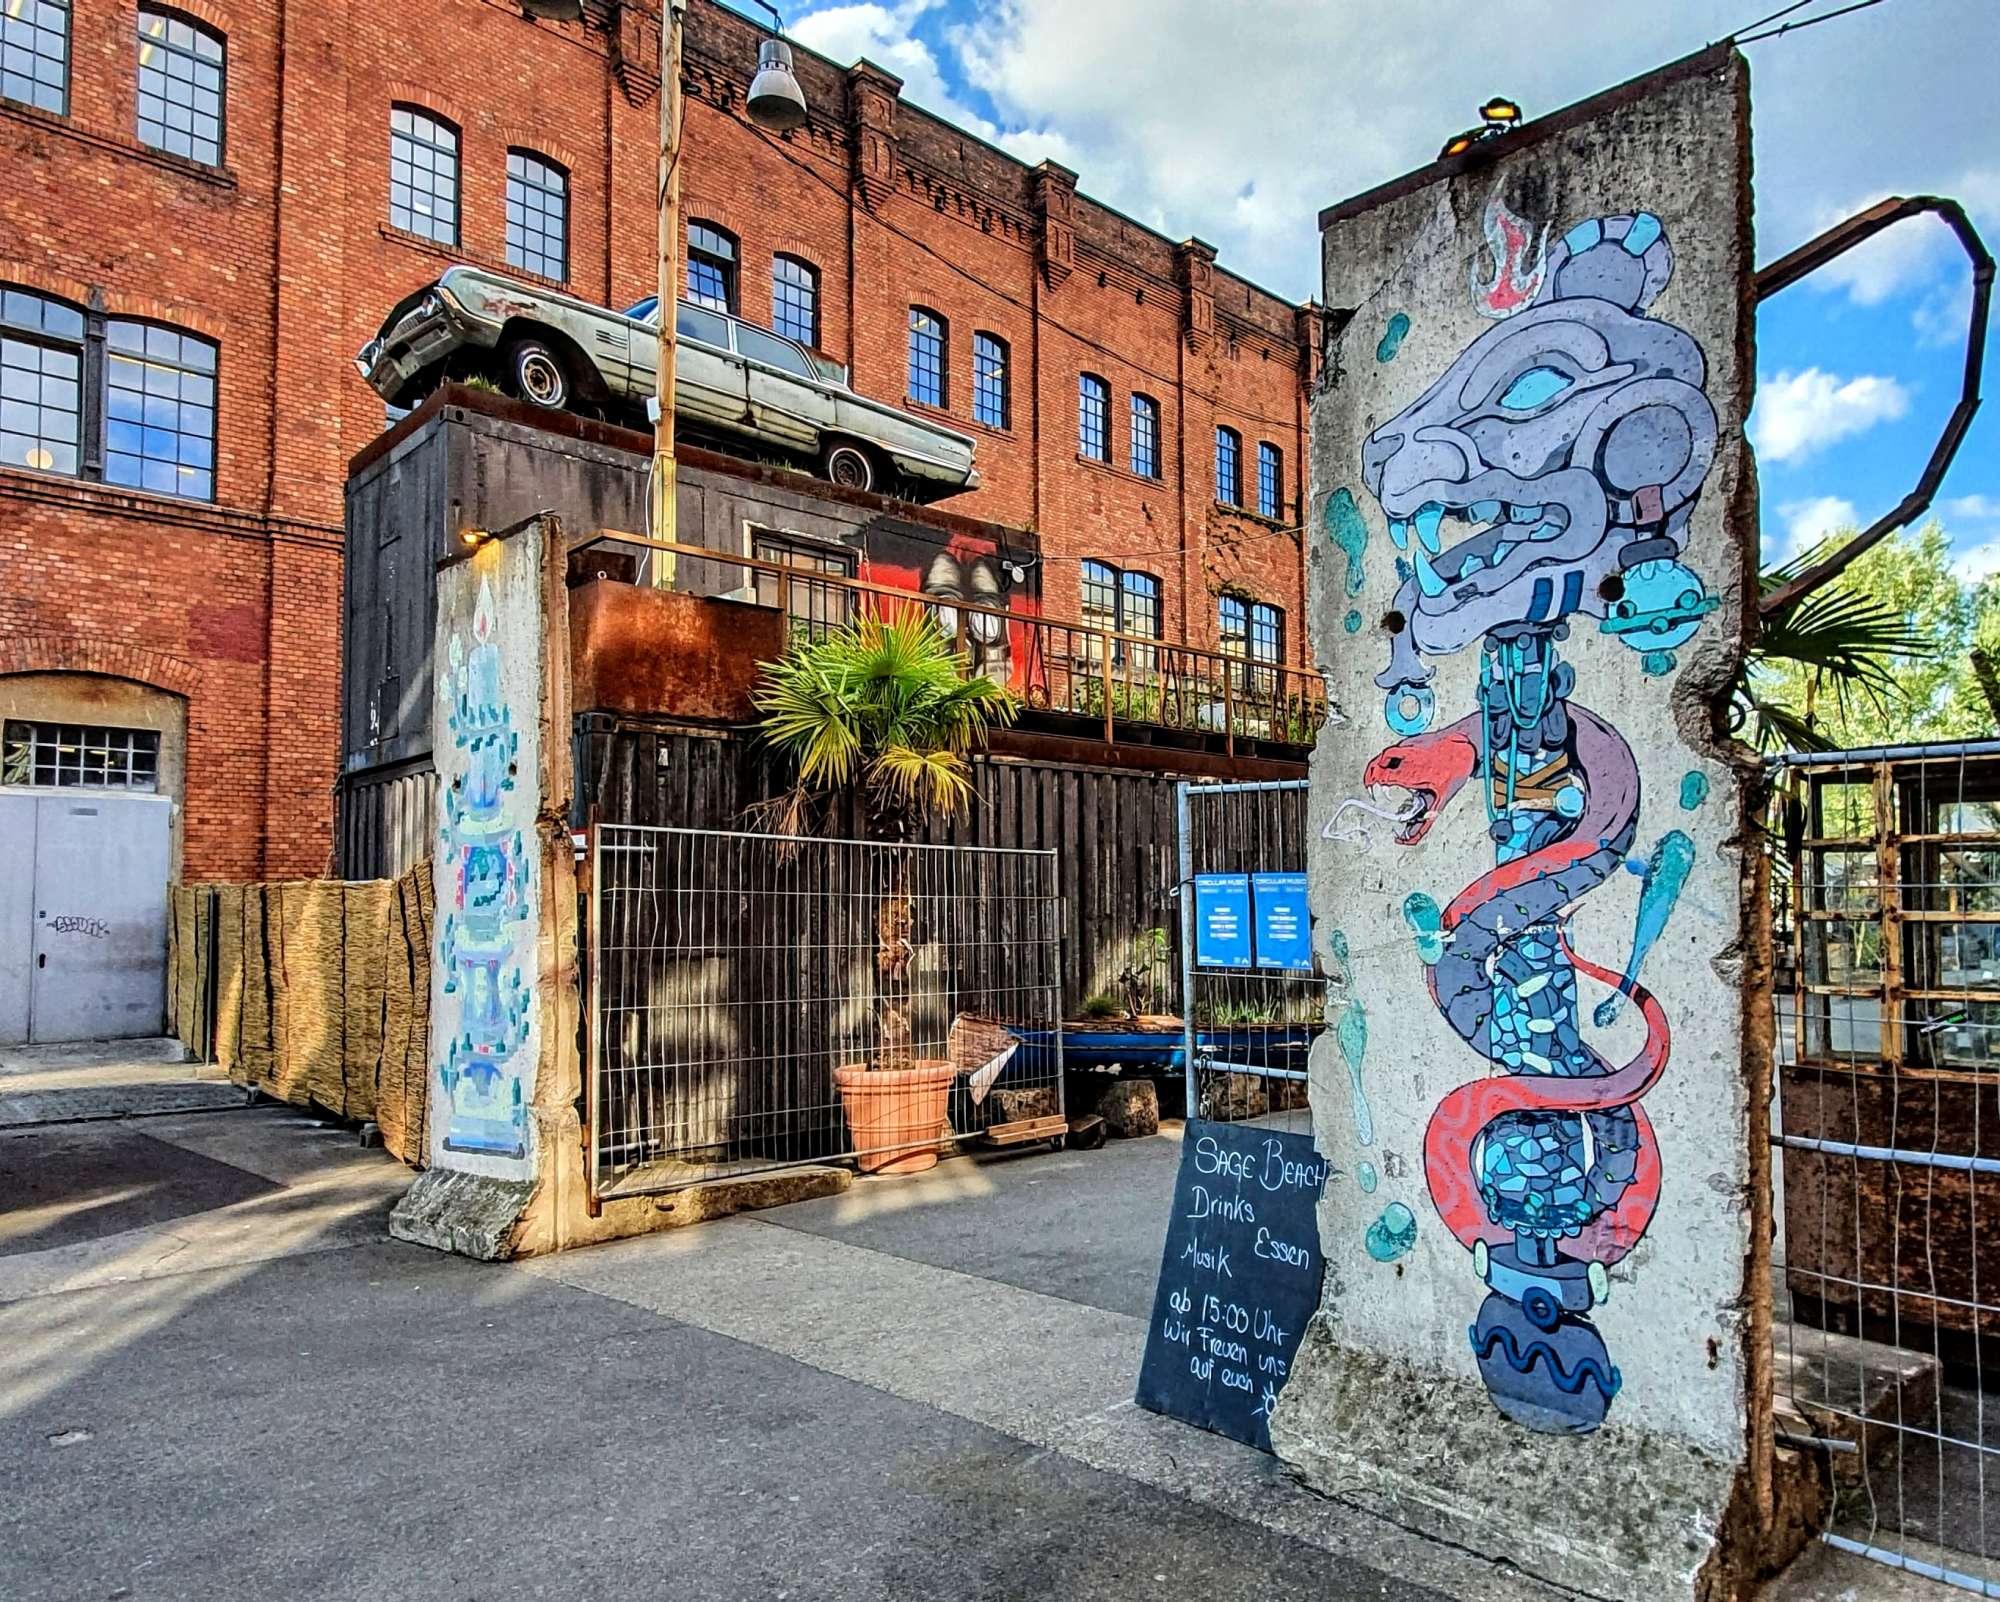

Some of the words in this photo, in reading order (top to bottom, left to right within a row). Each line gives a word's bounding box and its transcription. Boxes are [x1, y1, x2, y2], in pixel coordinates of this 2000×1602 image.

[1194, 1136, 1256, 1180] SAGE
[1259, 1138, 1327, 1191] BEACH
[1186, 1185, 1255, 1223] Drinks
[1181, 1237, 1233, 1278] Musik
[1254, 1226, 1309, 1271] Essen
[1169, 1287, 1191, 1313] ab
[1201, 1294, 1249, 1334] 15:00
[1253, 1307, 1291, 1347] Uhr
[1163, 1319, 1191, 1347] Wir
[1197, 1326, 1248, 1366] Freuen
[1258, 1351, 1286, 1376] uns
[1190, 1356, 1214, 1380] auf
[1221, 1367, 1253, 1394] euch
